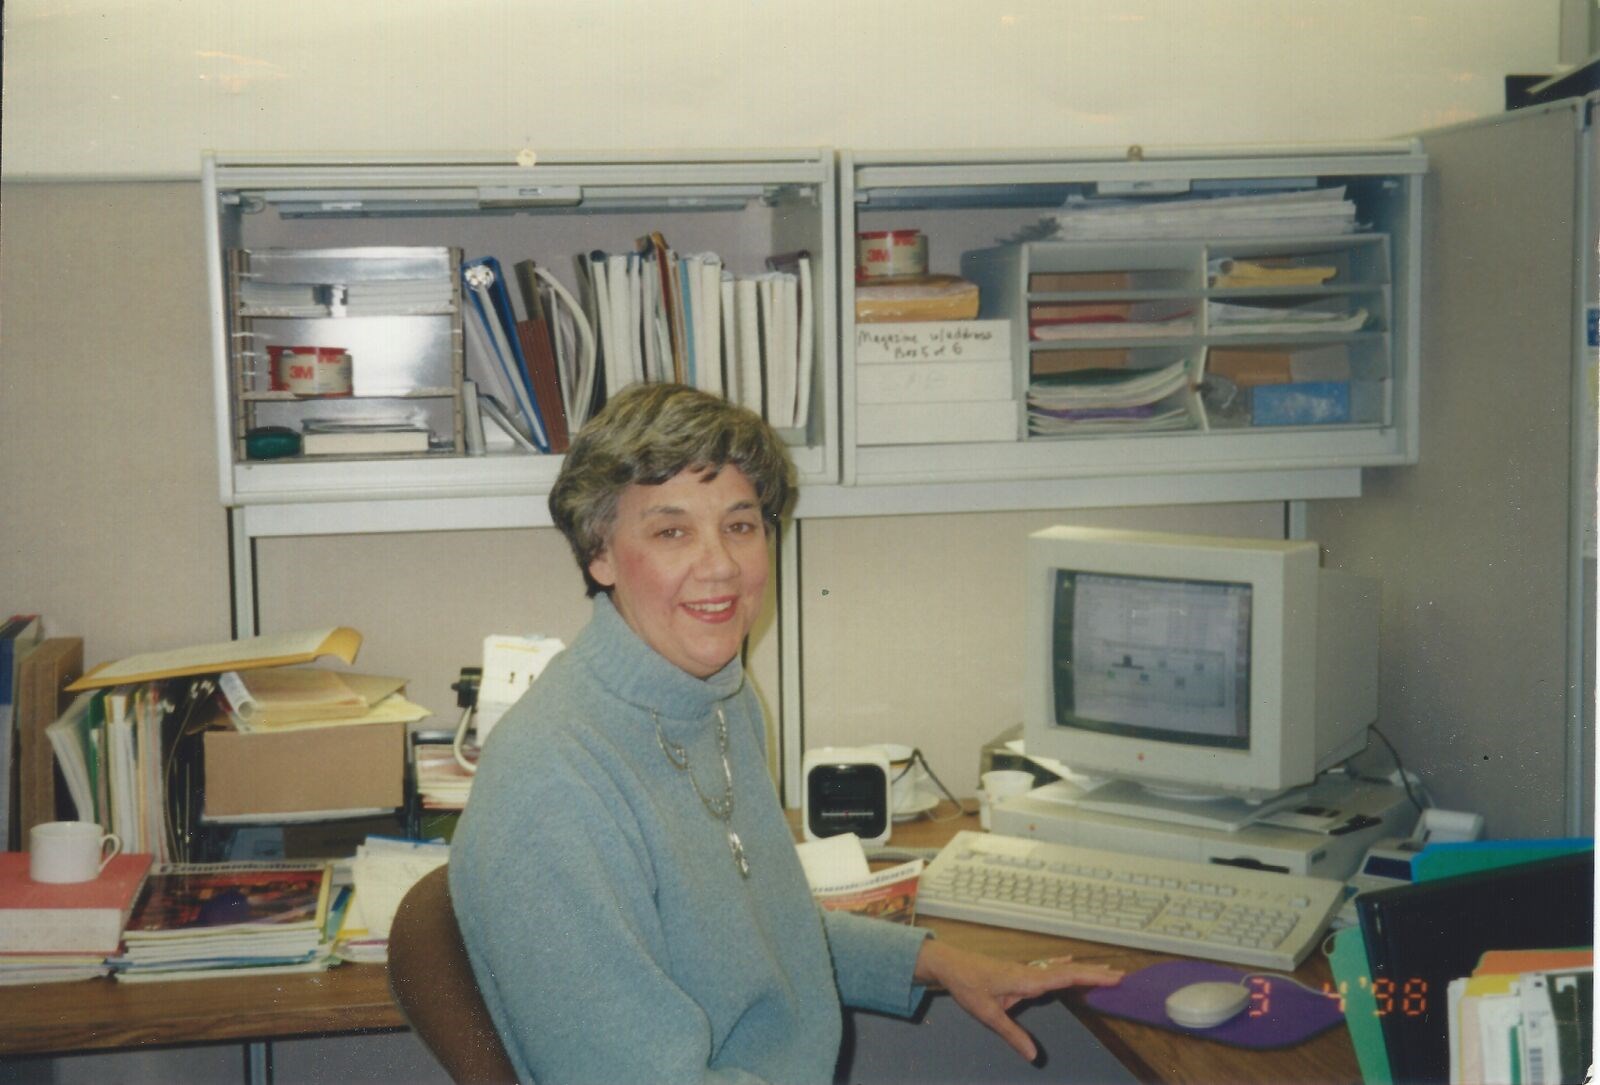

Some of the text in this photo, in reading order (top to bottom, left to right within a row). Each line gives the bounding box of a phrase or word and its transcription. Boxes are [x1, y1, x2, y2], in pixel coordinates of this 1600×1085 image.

[867, 248, 891, 262] 3M
[857, 330, 918, 351] Magazine
[894, 346, 917, 359] Box
[933, 344, 946, 356] of
[951, 341, 963, 355] 6
[288, 365, 314, 380] 3M
